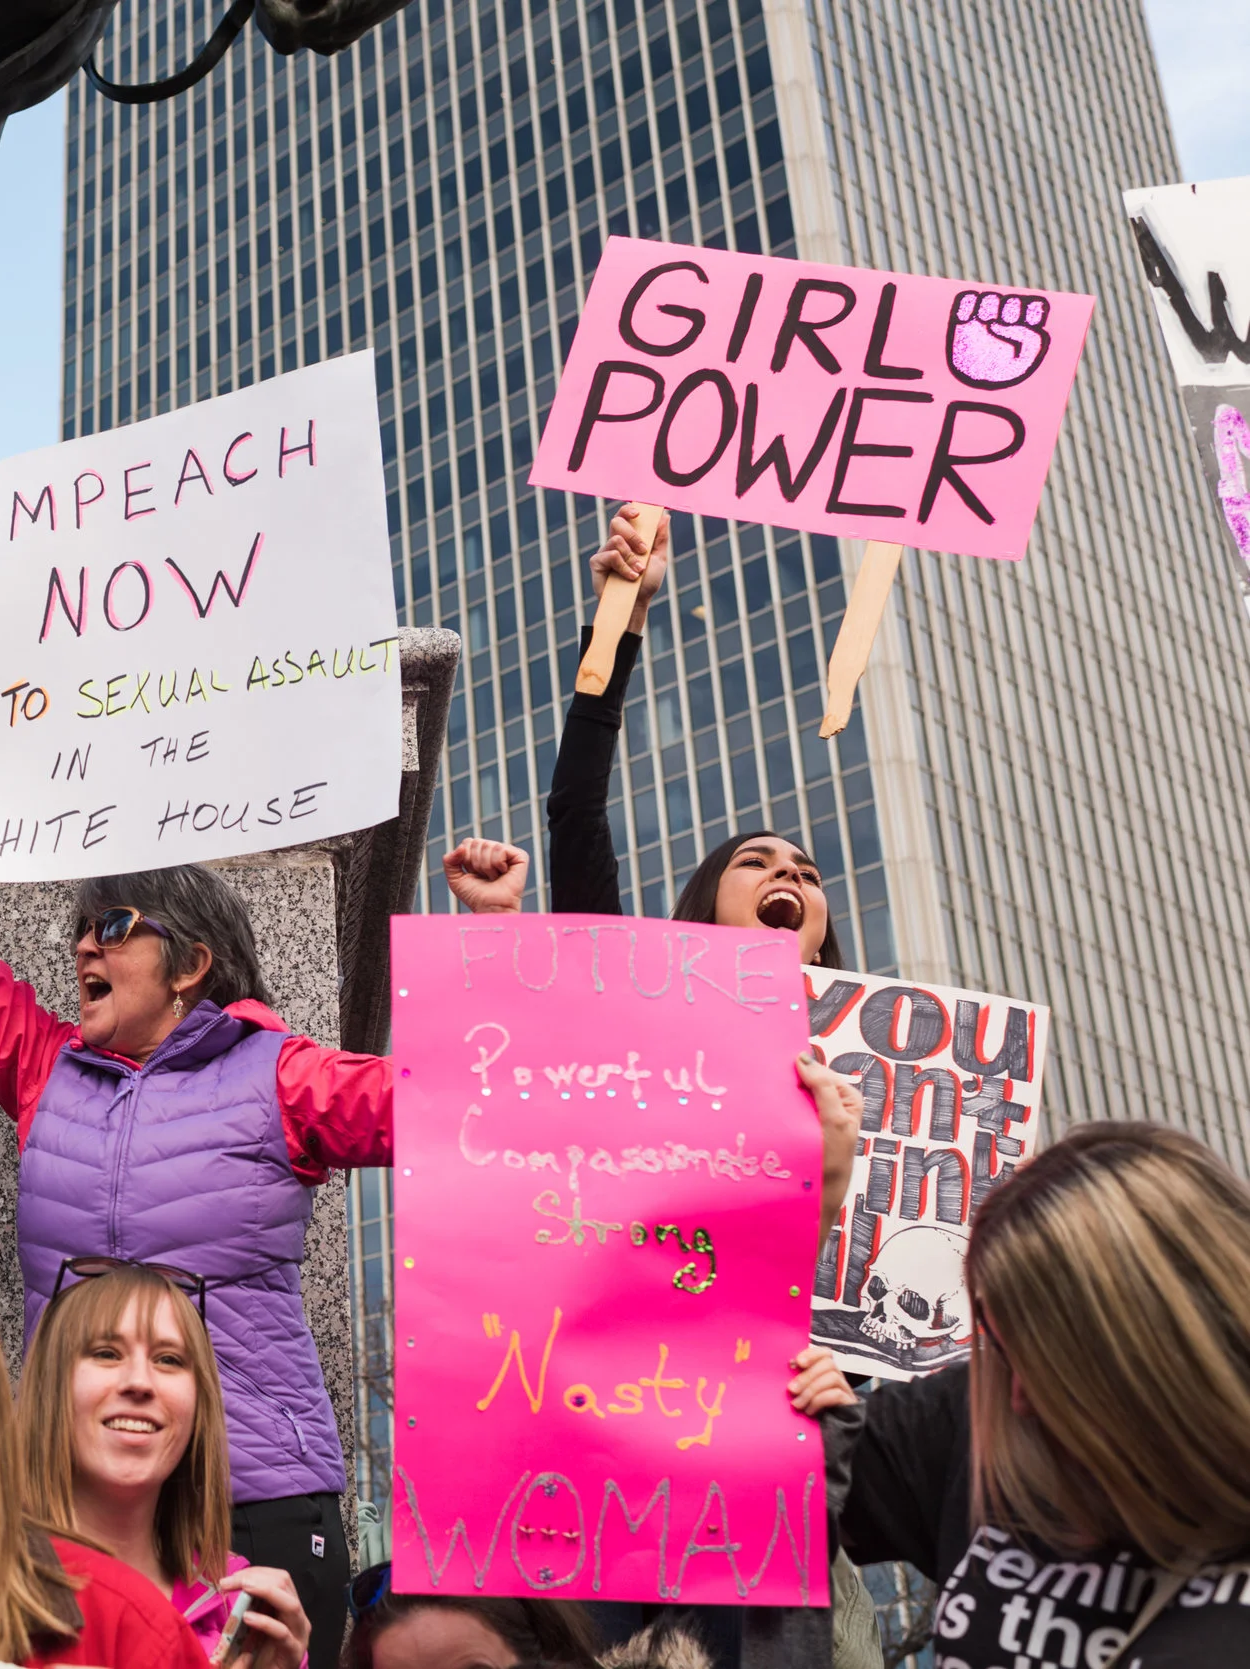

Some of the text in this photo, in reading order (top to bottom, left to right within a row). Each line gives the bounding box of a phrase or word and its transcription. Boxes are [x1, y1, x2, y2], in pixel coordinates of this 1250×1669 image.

[618, 260, 924, 381] GIRL
[567, 361, 1026, 526] POWER
[39, 532, 265, 645] NOW
[1, 679, 50, 728] TO
[76, 667, 230, 720] SEXUAL
[245, 636, 399, 692] ASSAULT
[51, 730, 210, 782] IN THE
[158, 781, 328, 842] HOUSE
[459, 925, 786, 1013] FUTURE
[463, 1022, 728, 1100] Powerful
[812, 1045, 1031, 1157] an't
[533, 1190, 717, 1294] Strong
[397, 1465, 817, 1607] WOMAN
[998, 1594, 1129, 1669] the
